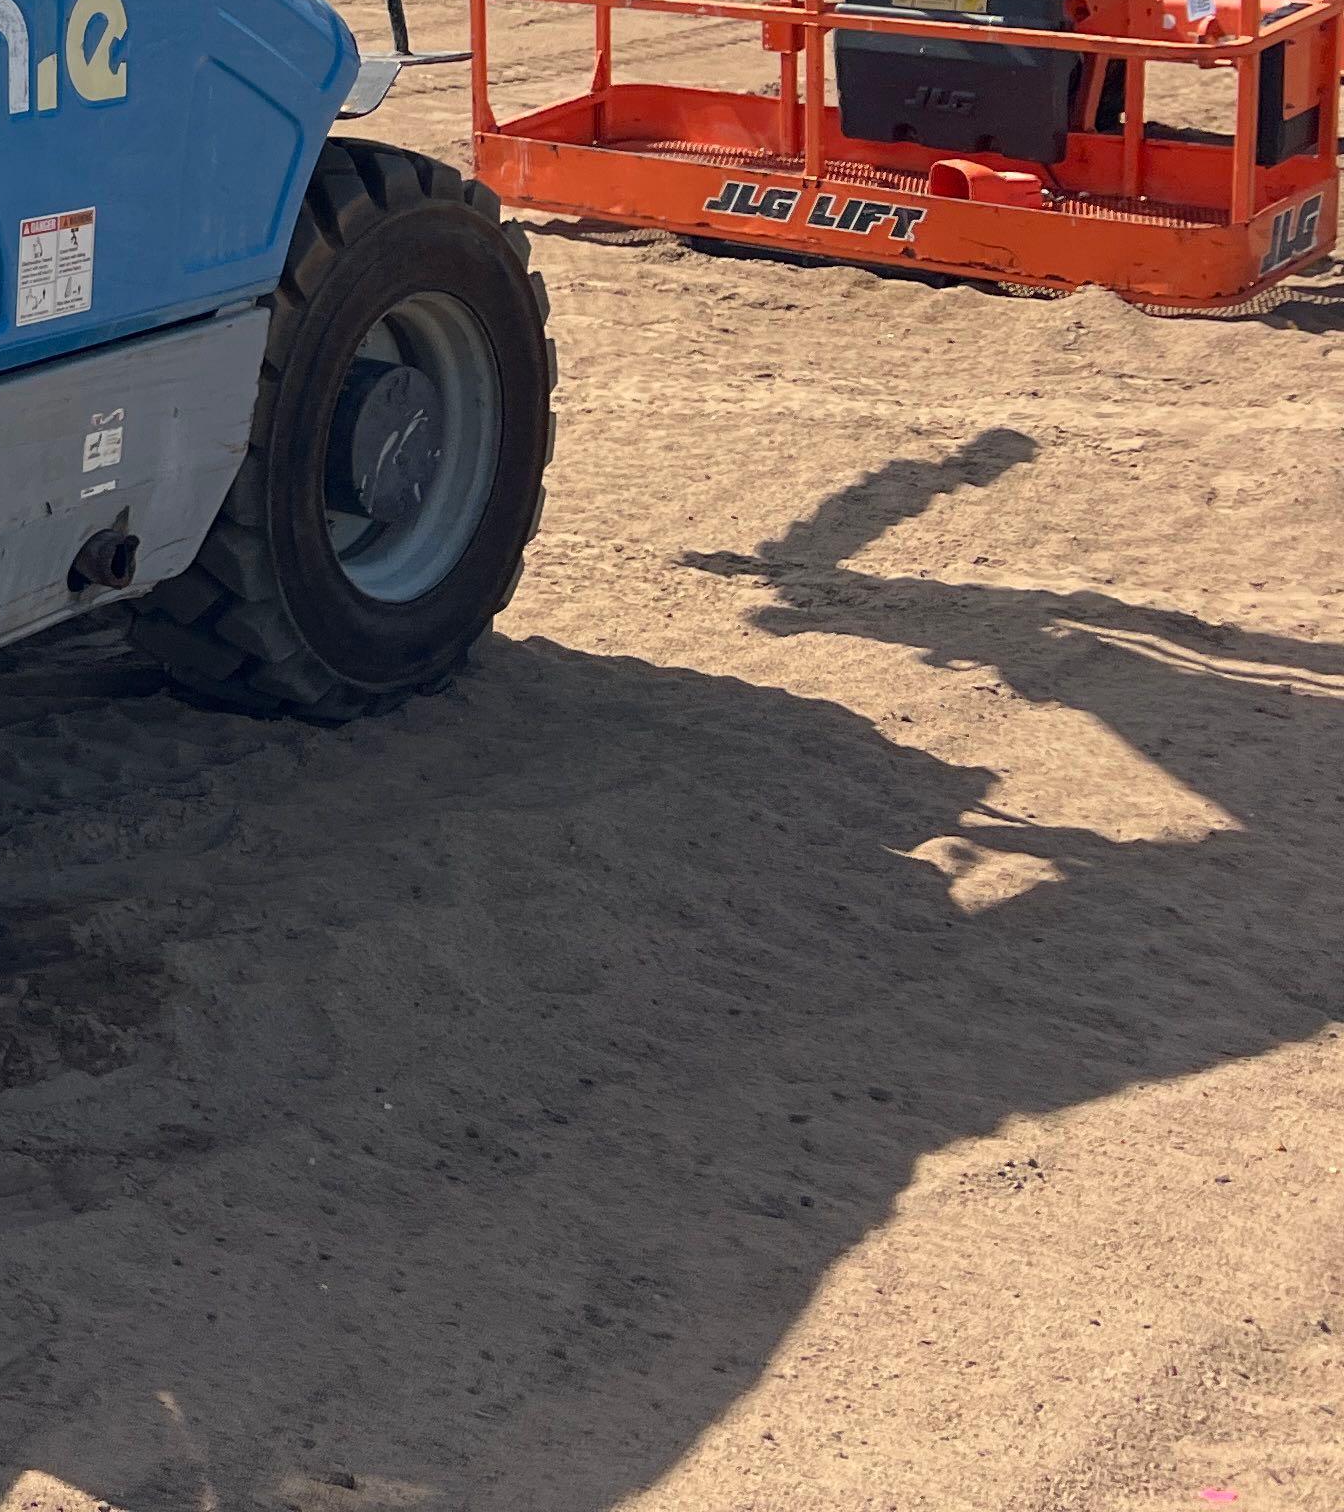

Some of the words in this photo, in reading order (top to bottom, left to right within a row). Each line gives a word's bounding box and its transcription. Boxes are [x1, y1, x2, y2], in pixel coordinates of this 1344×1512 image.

[702, 180, 801, 222] JLG
[807, 193, 927, 242] LIFT
[1258, 192, 1324, 278] JLG
